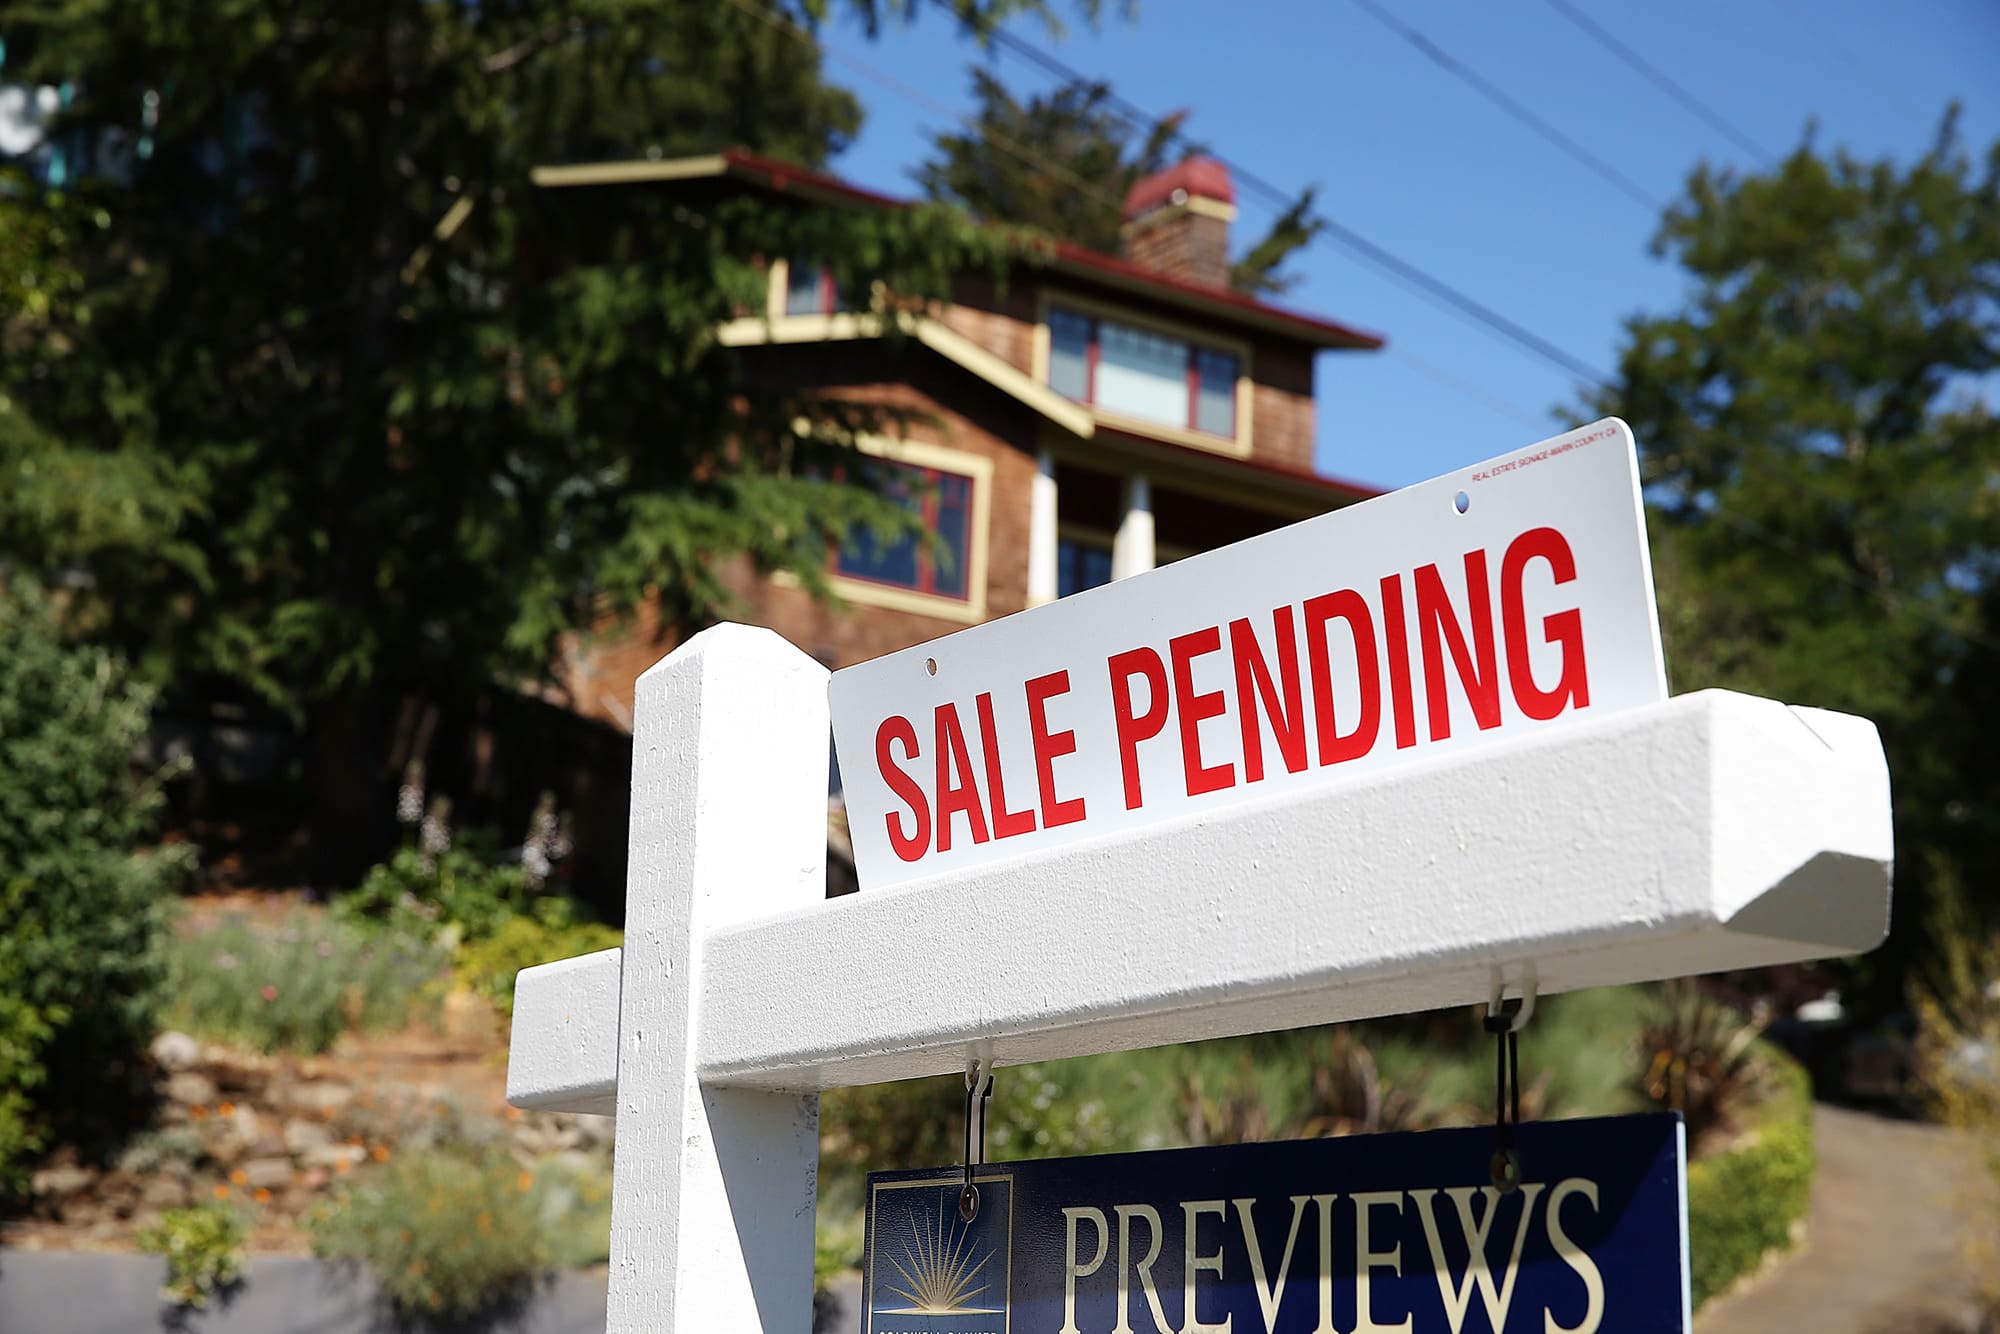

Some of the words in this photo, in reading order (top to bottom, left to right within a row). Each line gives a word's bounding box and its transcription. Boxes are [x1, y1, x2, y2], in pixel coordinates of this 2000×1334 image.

[1472, 472, 1490, 482] REAL
[1492, 461, 1516, 476] ESTATE
[876, 671, 1086, 862] SALE
[1109, 528, 1590, 810] PENDING
[1059, 1179, 1605, 1334] PREVIEWS
